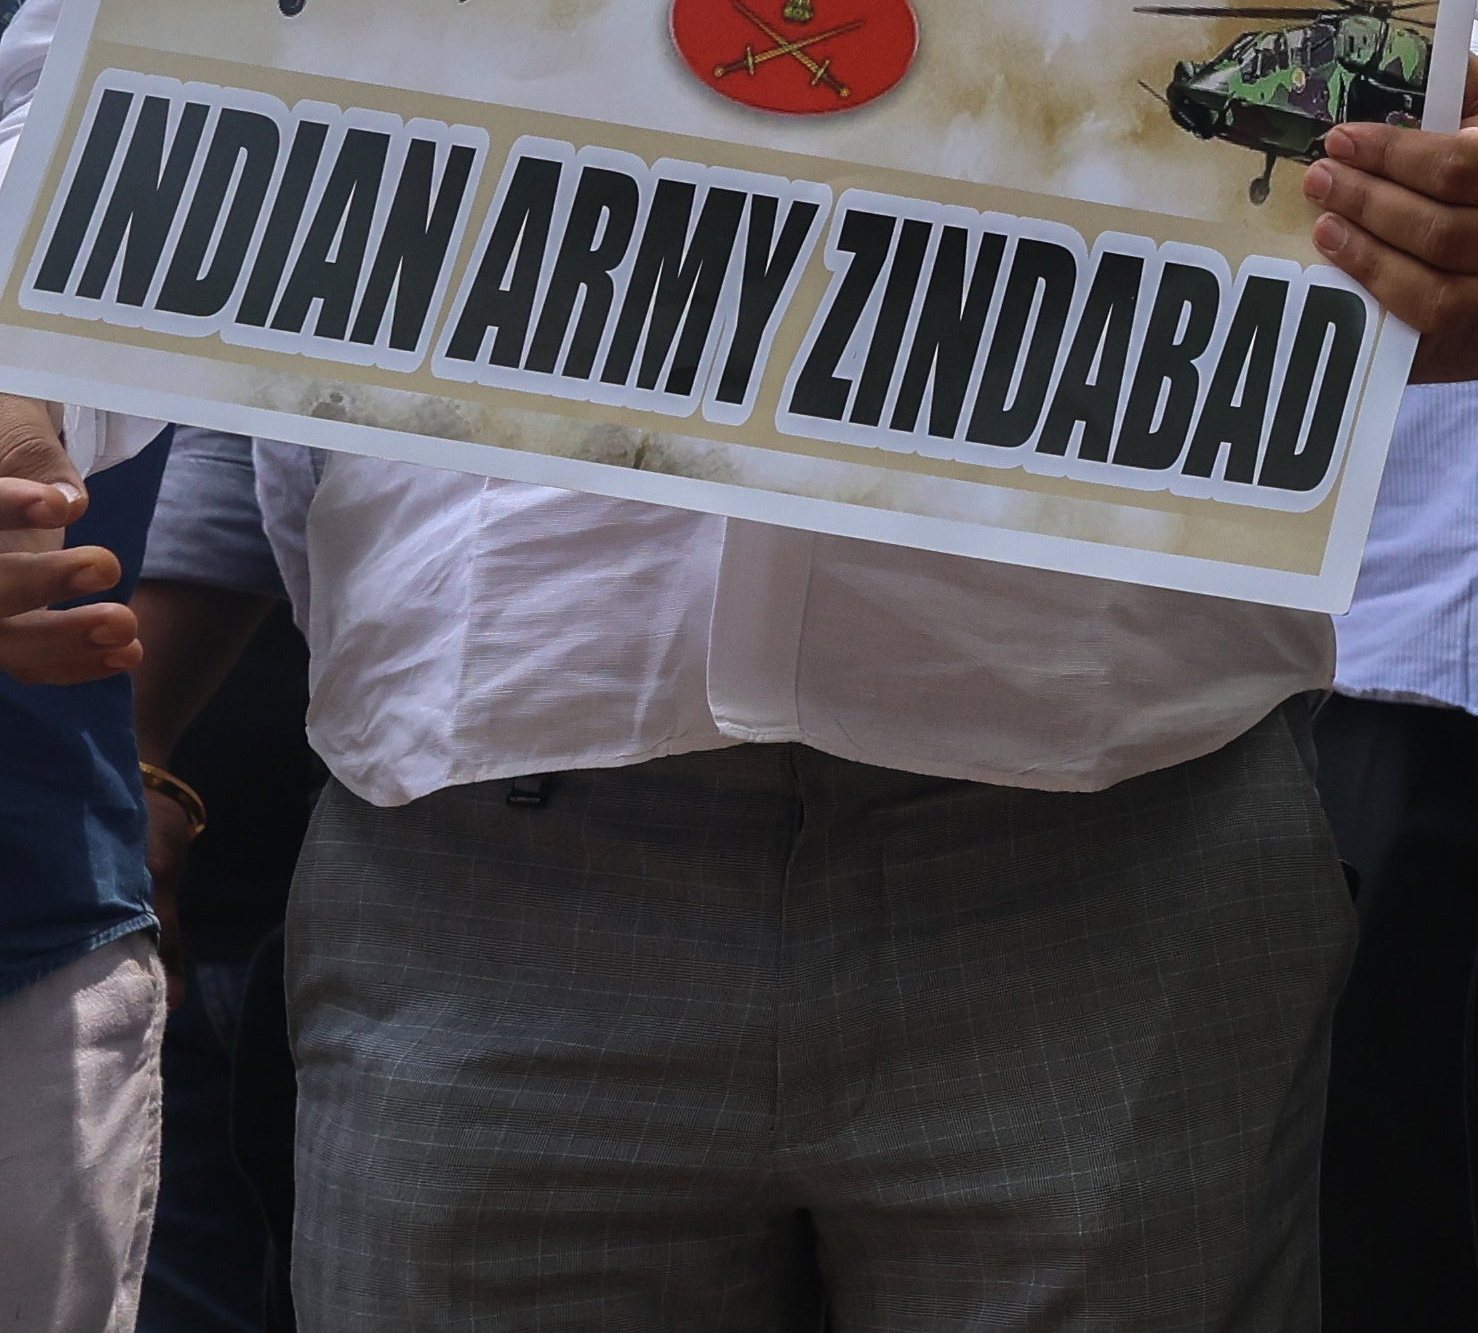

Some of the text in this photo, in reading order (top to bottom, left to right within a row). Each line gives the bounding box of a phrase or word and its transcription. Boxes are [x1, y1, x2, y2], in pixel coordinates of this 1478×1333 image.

[33, 89, 1368, 493] INDIAN ARMY ZINDABAD
